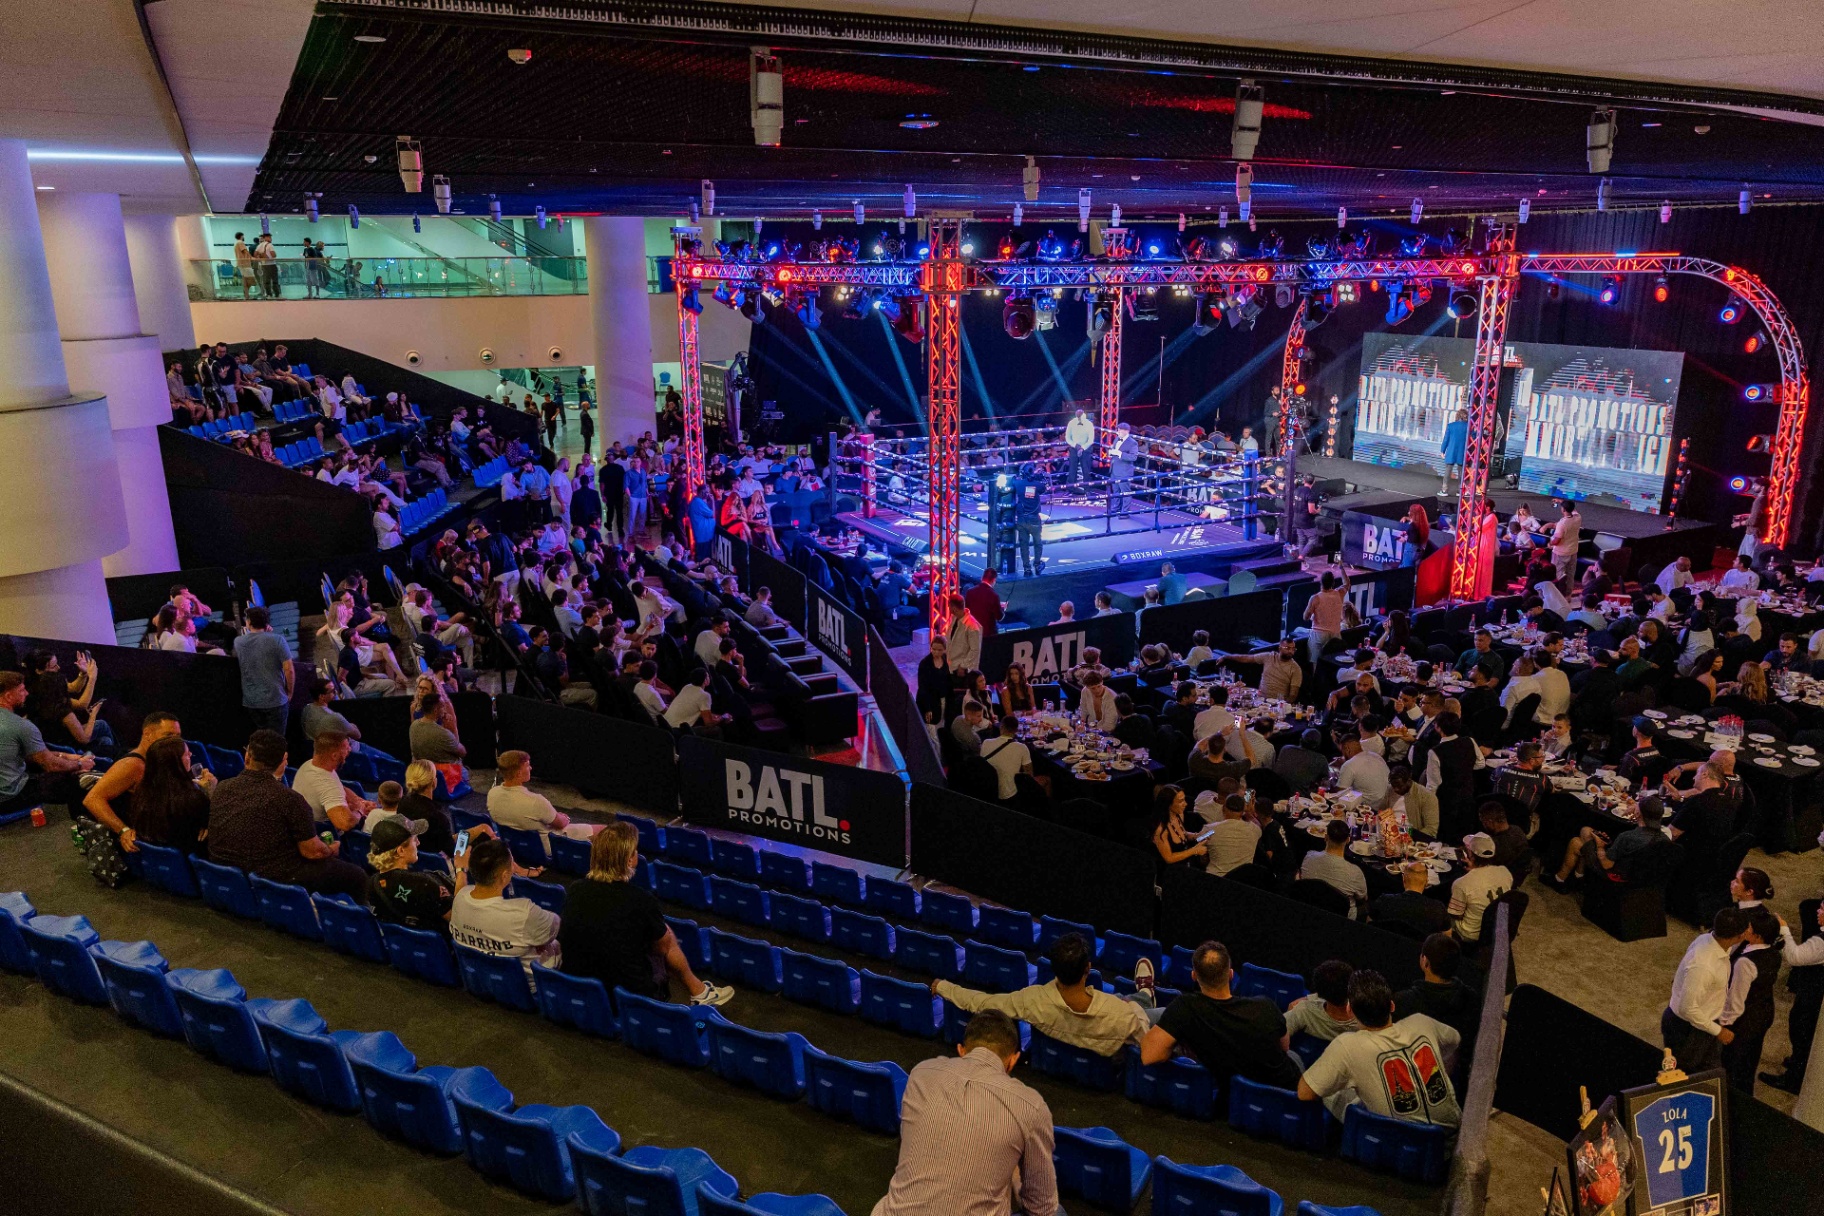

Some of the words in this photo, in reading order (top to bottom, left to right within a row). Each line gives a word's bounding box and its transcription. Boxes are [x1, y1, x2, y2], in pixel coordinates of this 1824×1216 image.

[1130, 550, 1163, 560] BOXRAW
[1363, 523, 1408, 560] BAT
[728, 808, 851, 845] PROMOTIONS
[1661, 1107, 1688, 1123] ZOLA
[1658, 1124, 1693, 1174] 25
